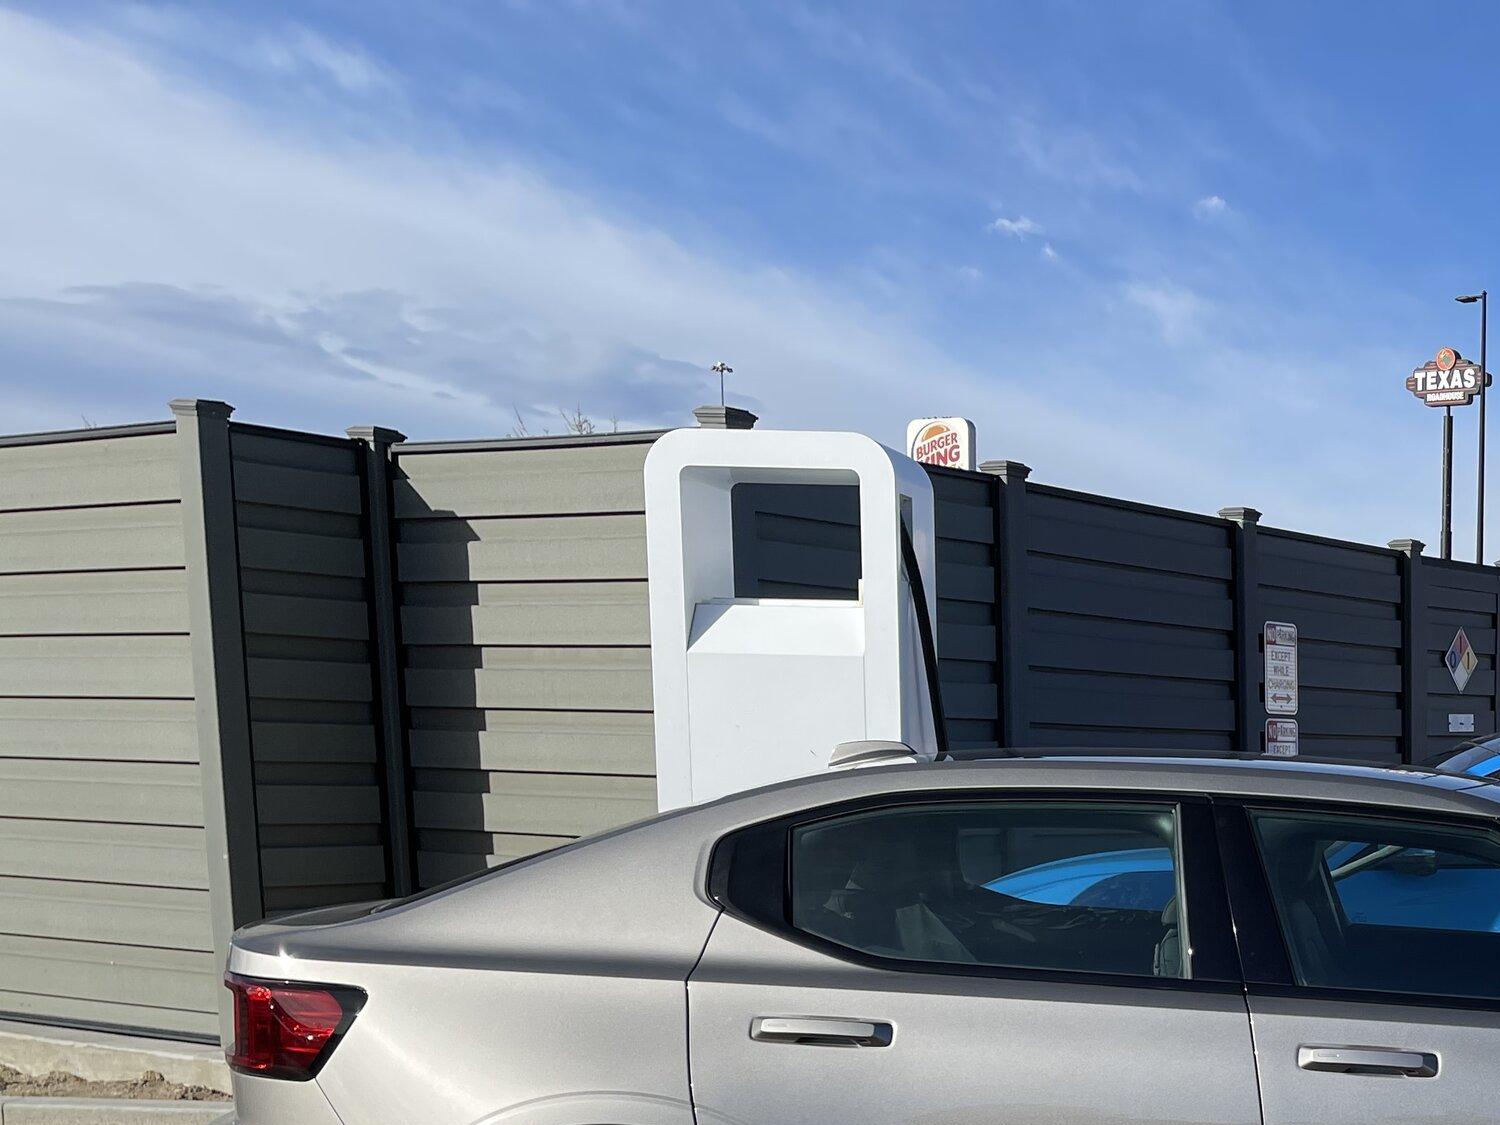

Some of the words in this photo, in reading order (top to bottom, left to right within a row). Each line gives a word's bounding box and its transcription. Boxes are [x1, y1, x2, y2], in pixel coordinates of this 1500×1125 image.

[1414, 368, 1476, 391] TEXAS
[916, 432, 958, 460] BURGER
[1271, 650, 1291, 661] EXCEPT
